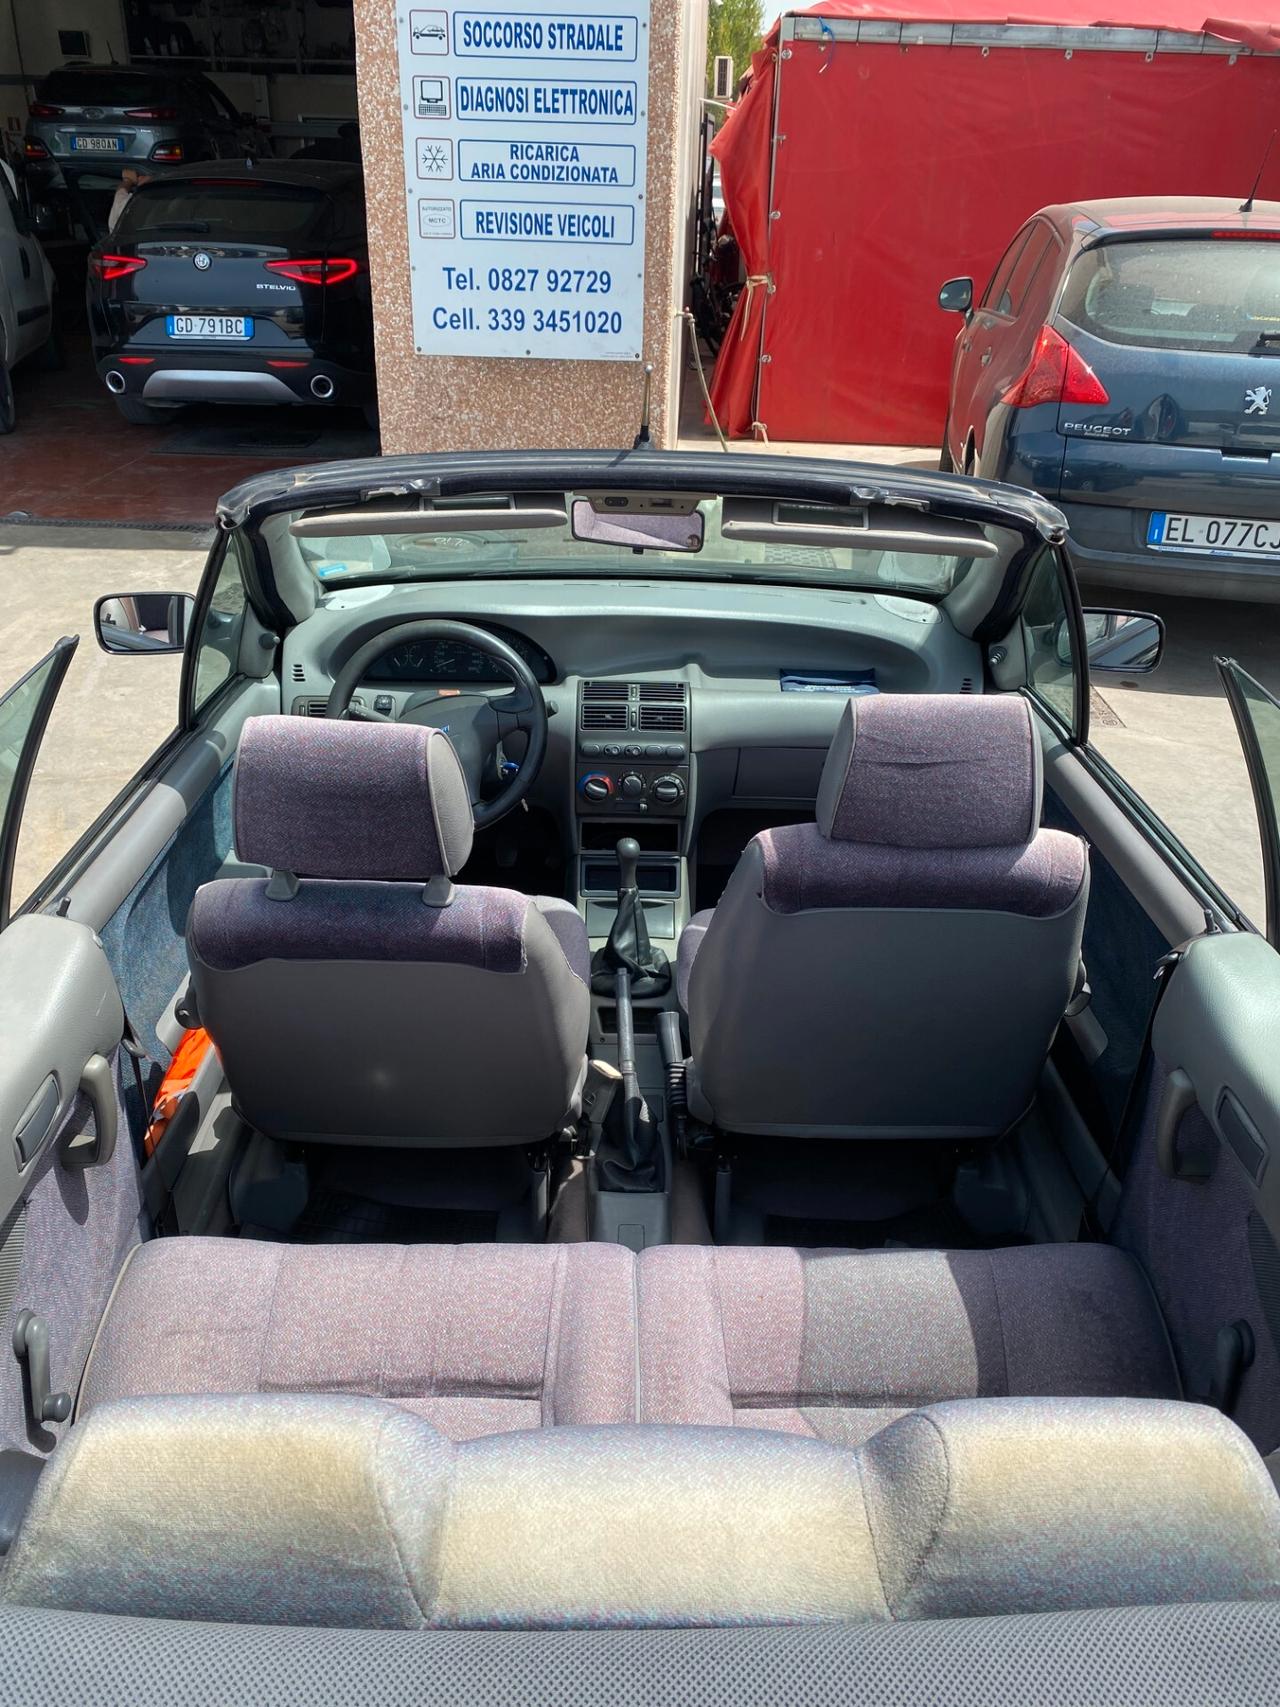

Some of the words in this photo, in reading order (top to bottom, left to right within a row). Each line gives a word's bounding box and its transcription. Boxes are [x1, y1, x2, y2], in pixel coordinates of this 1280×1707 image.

[463, 20, 543, 49] SOCCORSO
[548, 22, 624, 51] STRADALE
[460, 85, 529, 113] DIAGNOSI
[534, 87, 633, 116] ELETTRONICA
[510, 144, 580, 162] RICARICA
[471, 163, 506, 179] ARIA
[510, 163, 619, 183] CONDIZIONATA
[475, 211, 553, 236] REVISIONE
[558, 214, 615, 238] VEICOLI
[256, 283, 296, 291] STELVIO
[442, 267, 480, 291] Tel.
[488, 268, 539, 292] 0827
[547, 269, 612, 294] 92729
[176, 318, 193, 333] GD
[199, 318, 243, 334] 791BC
[433, 306, 480, 331] Cell.
[488, 308, 525, 331] 339
[533, 309, 622, 334] 3451020
[1064, 422, 1132, 436] PEUGEOT
[1165, 517, 1194, 543] EL
